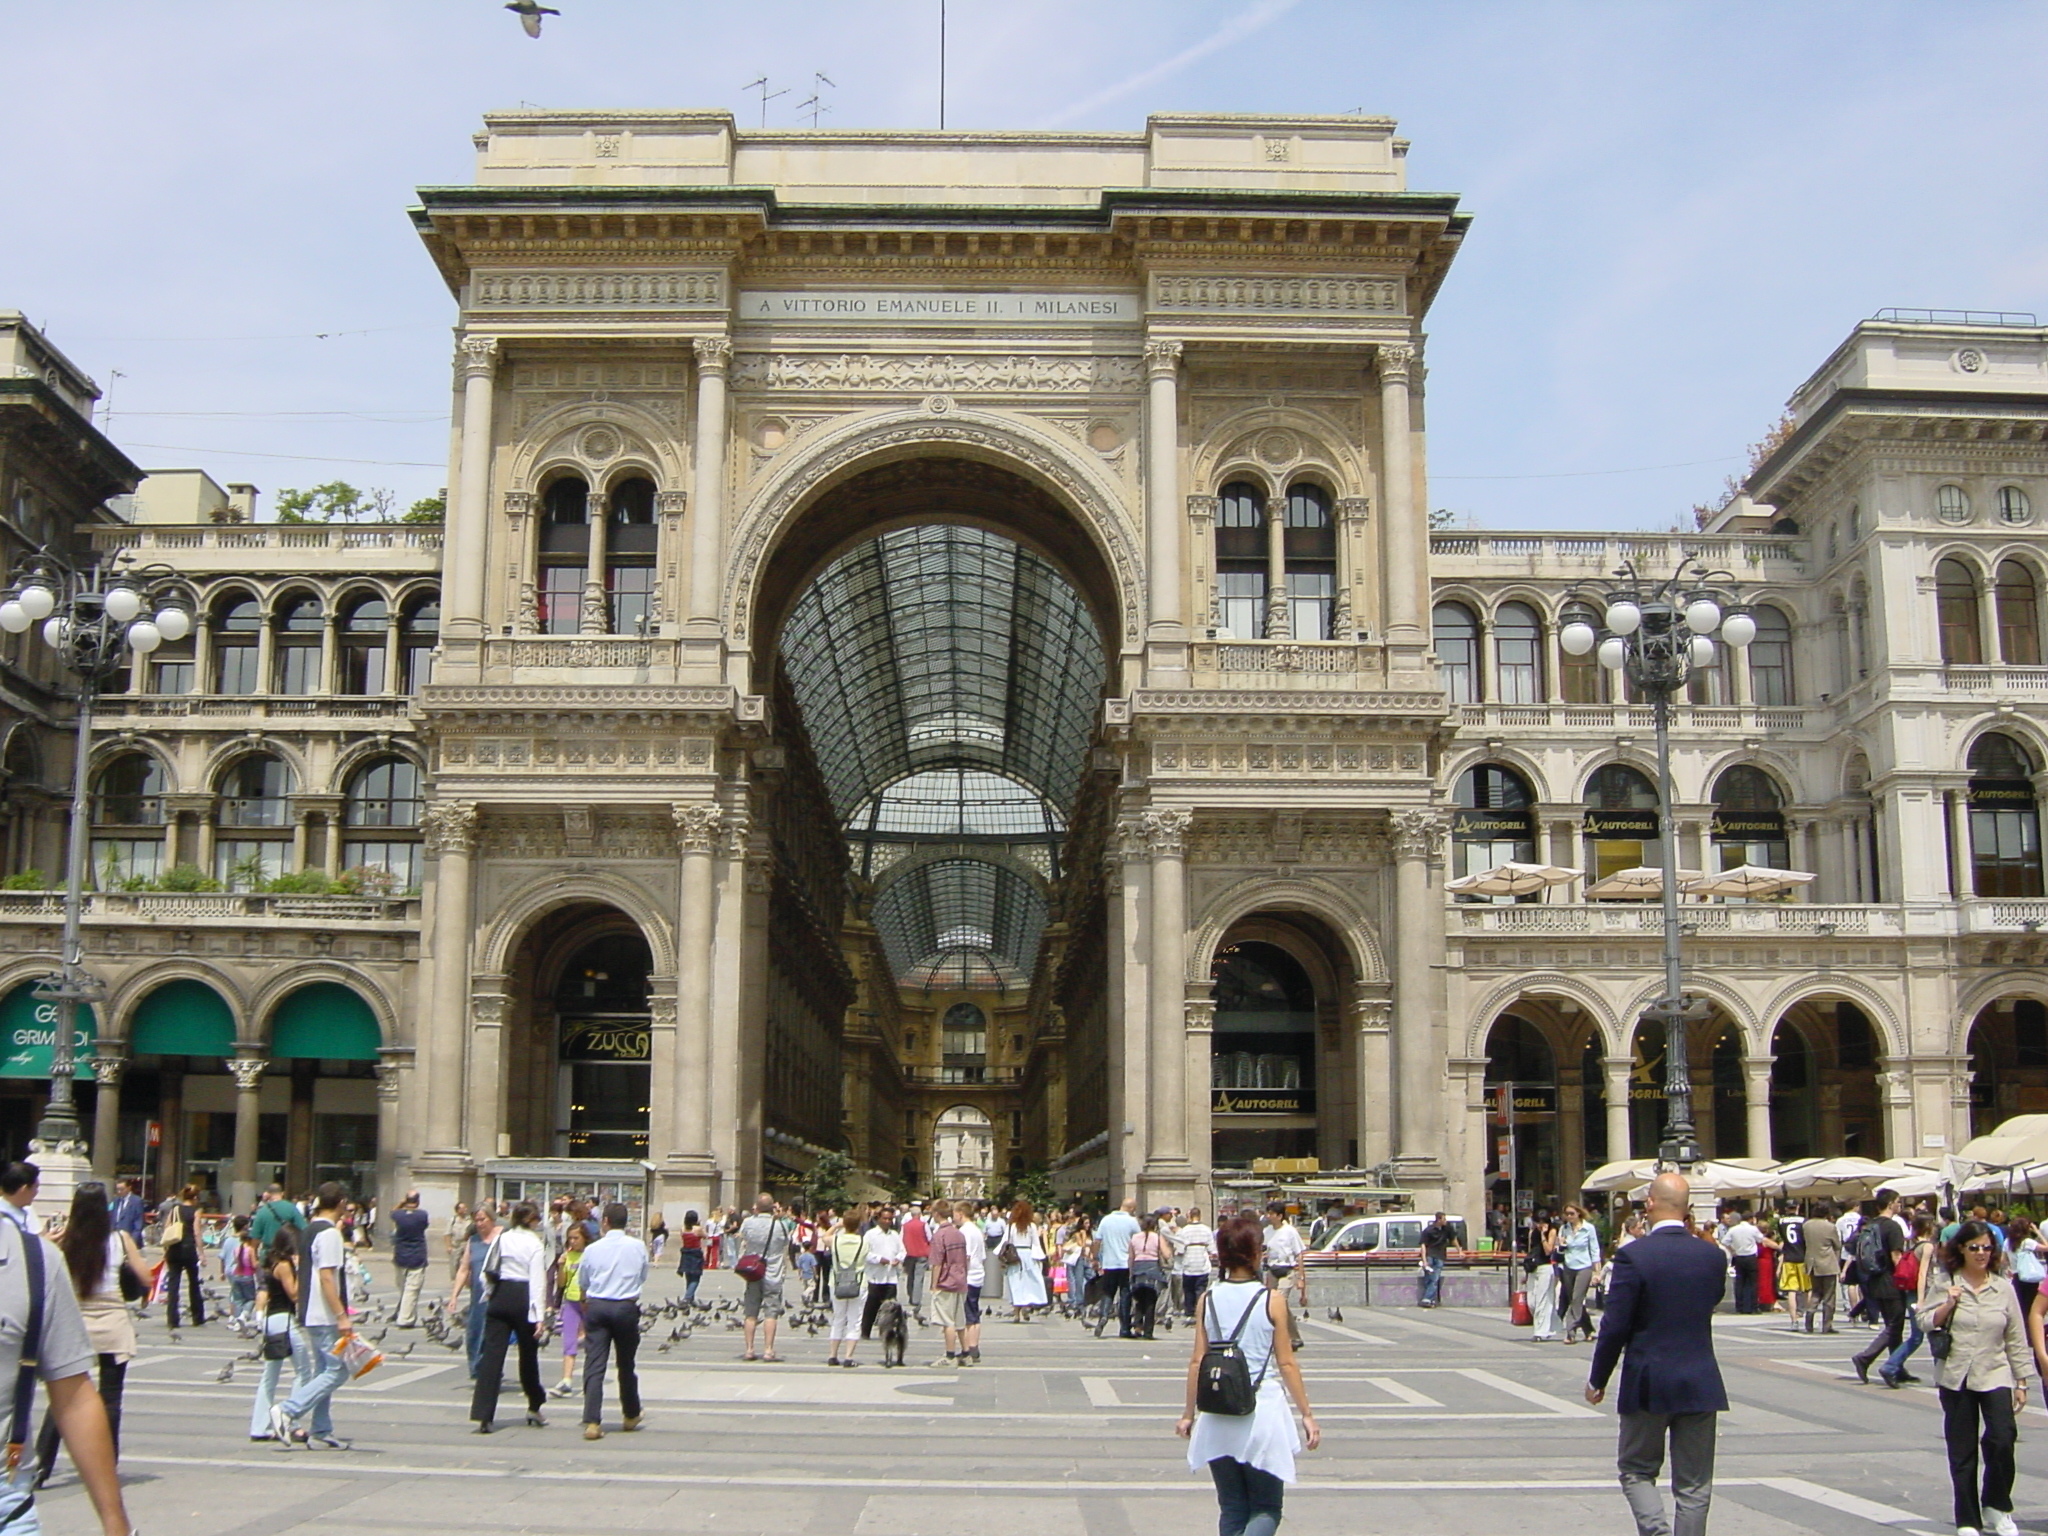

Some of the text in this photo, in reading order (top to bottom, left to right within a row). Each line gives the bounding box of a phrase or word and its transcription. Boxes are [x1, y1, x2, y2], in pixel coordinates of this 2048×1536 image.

[760, 300, 770, 311] A
[784, 299, 866, 312] VITTORIO
[877, 300, 976, 313] EMANUELE
[1035, 301, 1117, 314] MILANESI
[1473, 821, 1526, 829] AUTOGRILL
[1601, 822, 1653, 830] AUTOGRILL
[1728, 822, 1778, 830] AUTOGRILL
[13, 1029, 88, 1046] GRIMDI
[587, 1032, 649, 1058] ZUCCA
[1236, 1100, 1299, 1109] AUTOGRILL
[1786, 1223, 1797, 1243] 6
